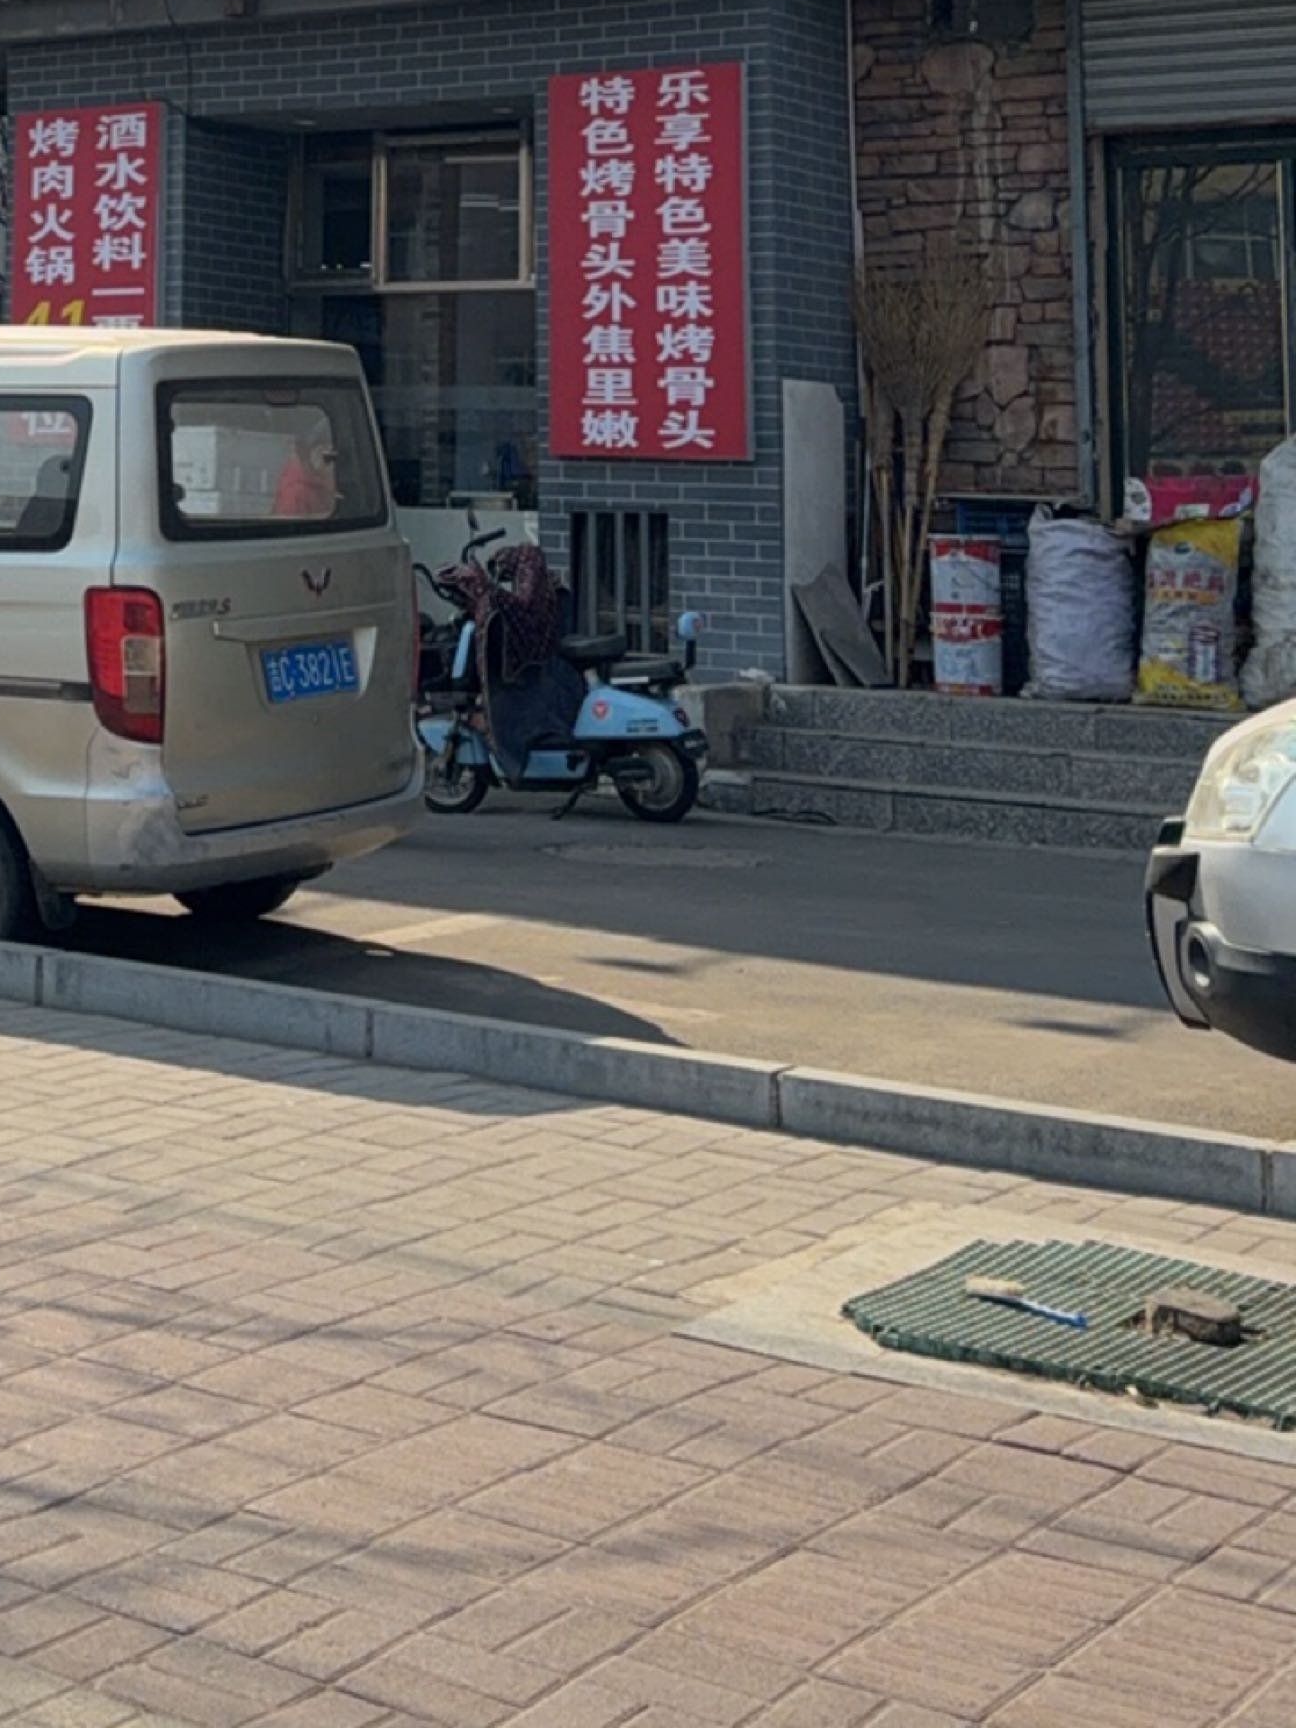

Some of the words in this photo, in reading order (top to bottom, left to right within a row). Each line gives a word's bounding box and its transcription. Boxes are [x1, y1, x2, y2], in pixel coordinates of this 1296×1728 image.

[579, 75, 640, 450] 特色烤骨头外焦里嫩
[654, 69, 716, 450] 乐享特色美味烤骨头
